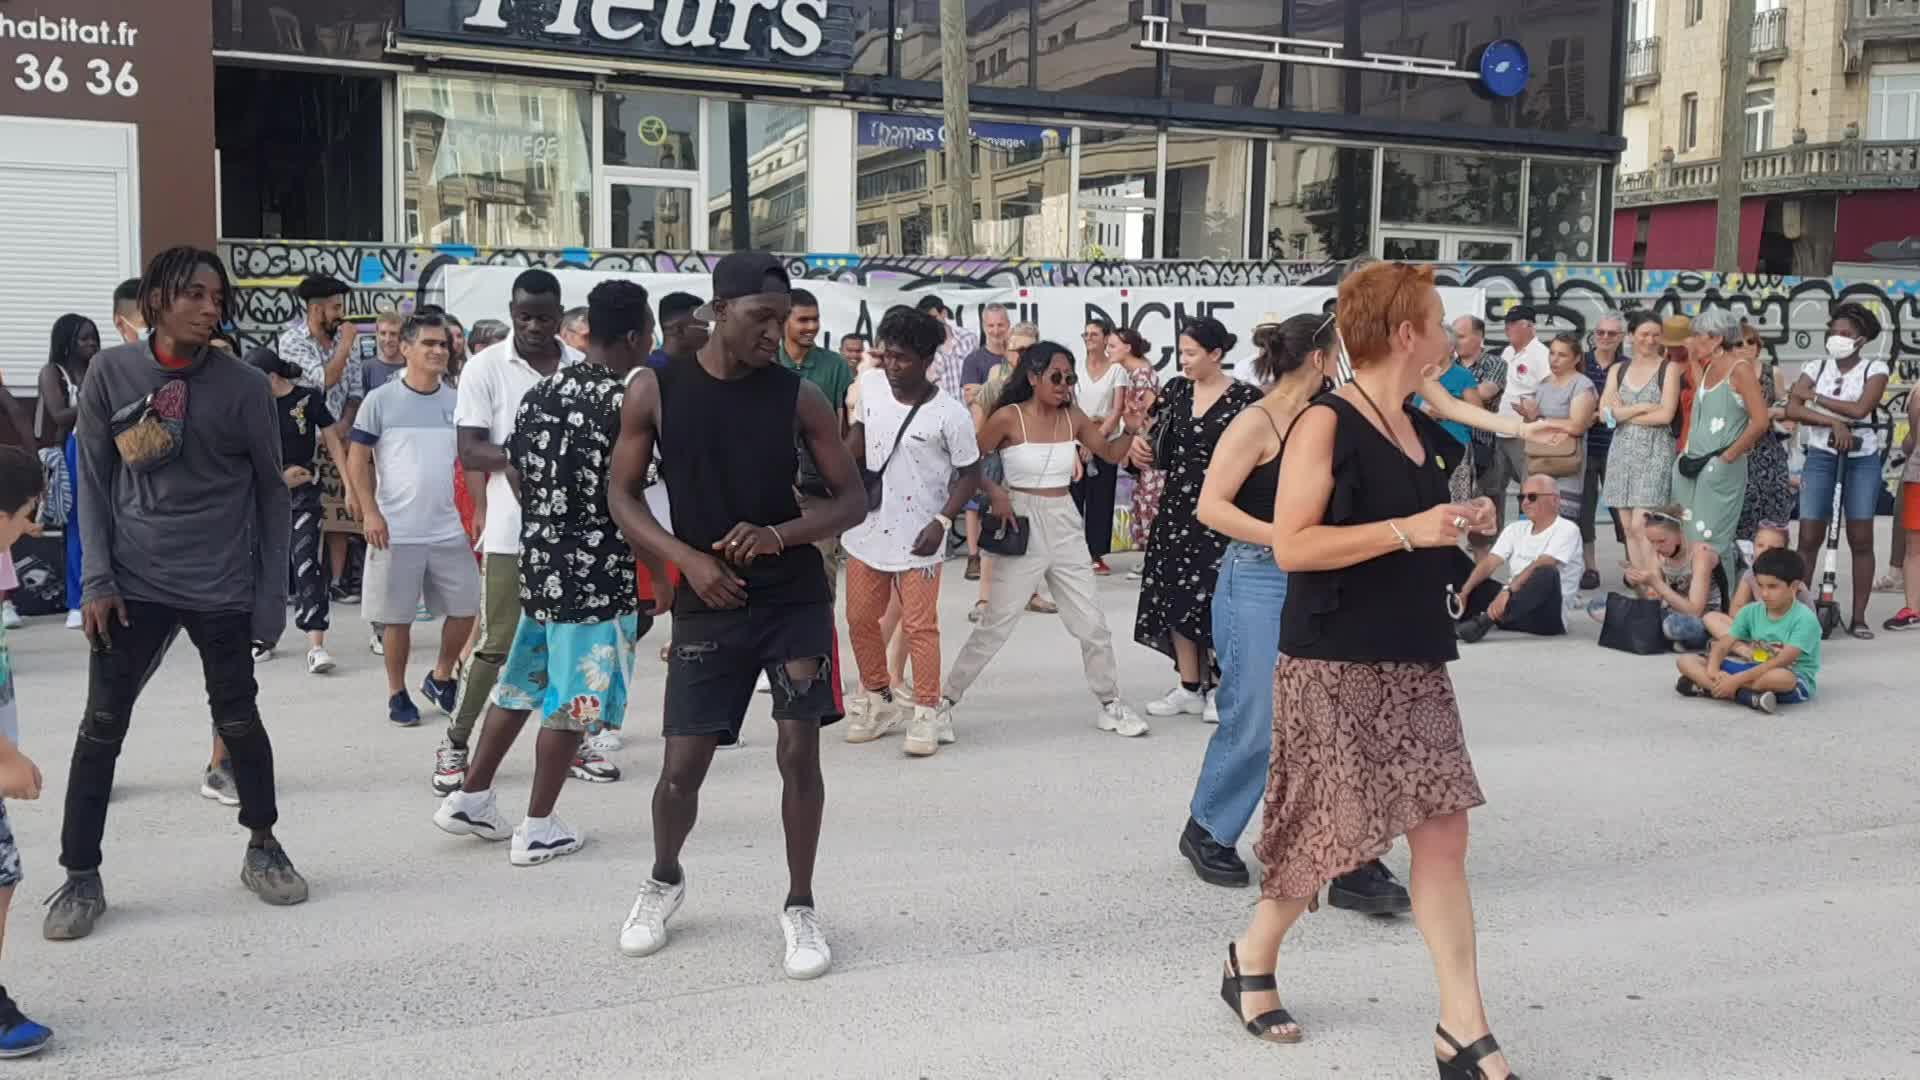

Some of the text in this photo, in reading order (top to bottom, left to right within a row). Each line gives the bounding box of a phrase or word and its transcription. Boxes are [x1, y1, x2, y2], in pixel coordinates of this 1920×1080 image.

[0, 12, 138, 46] habitat.fr
[14, 53, 139, 97] 36 36
